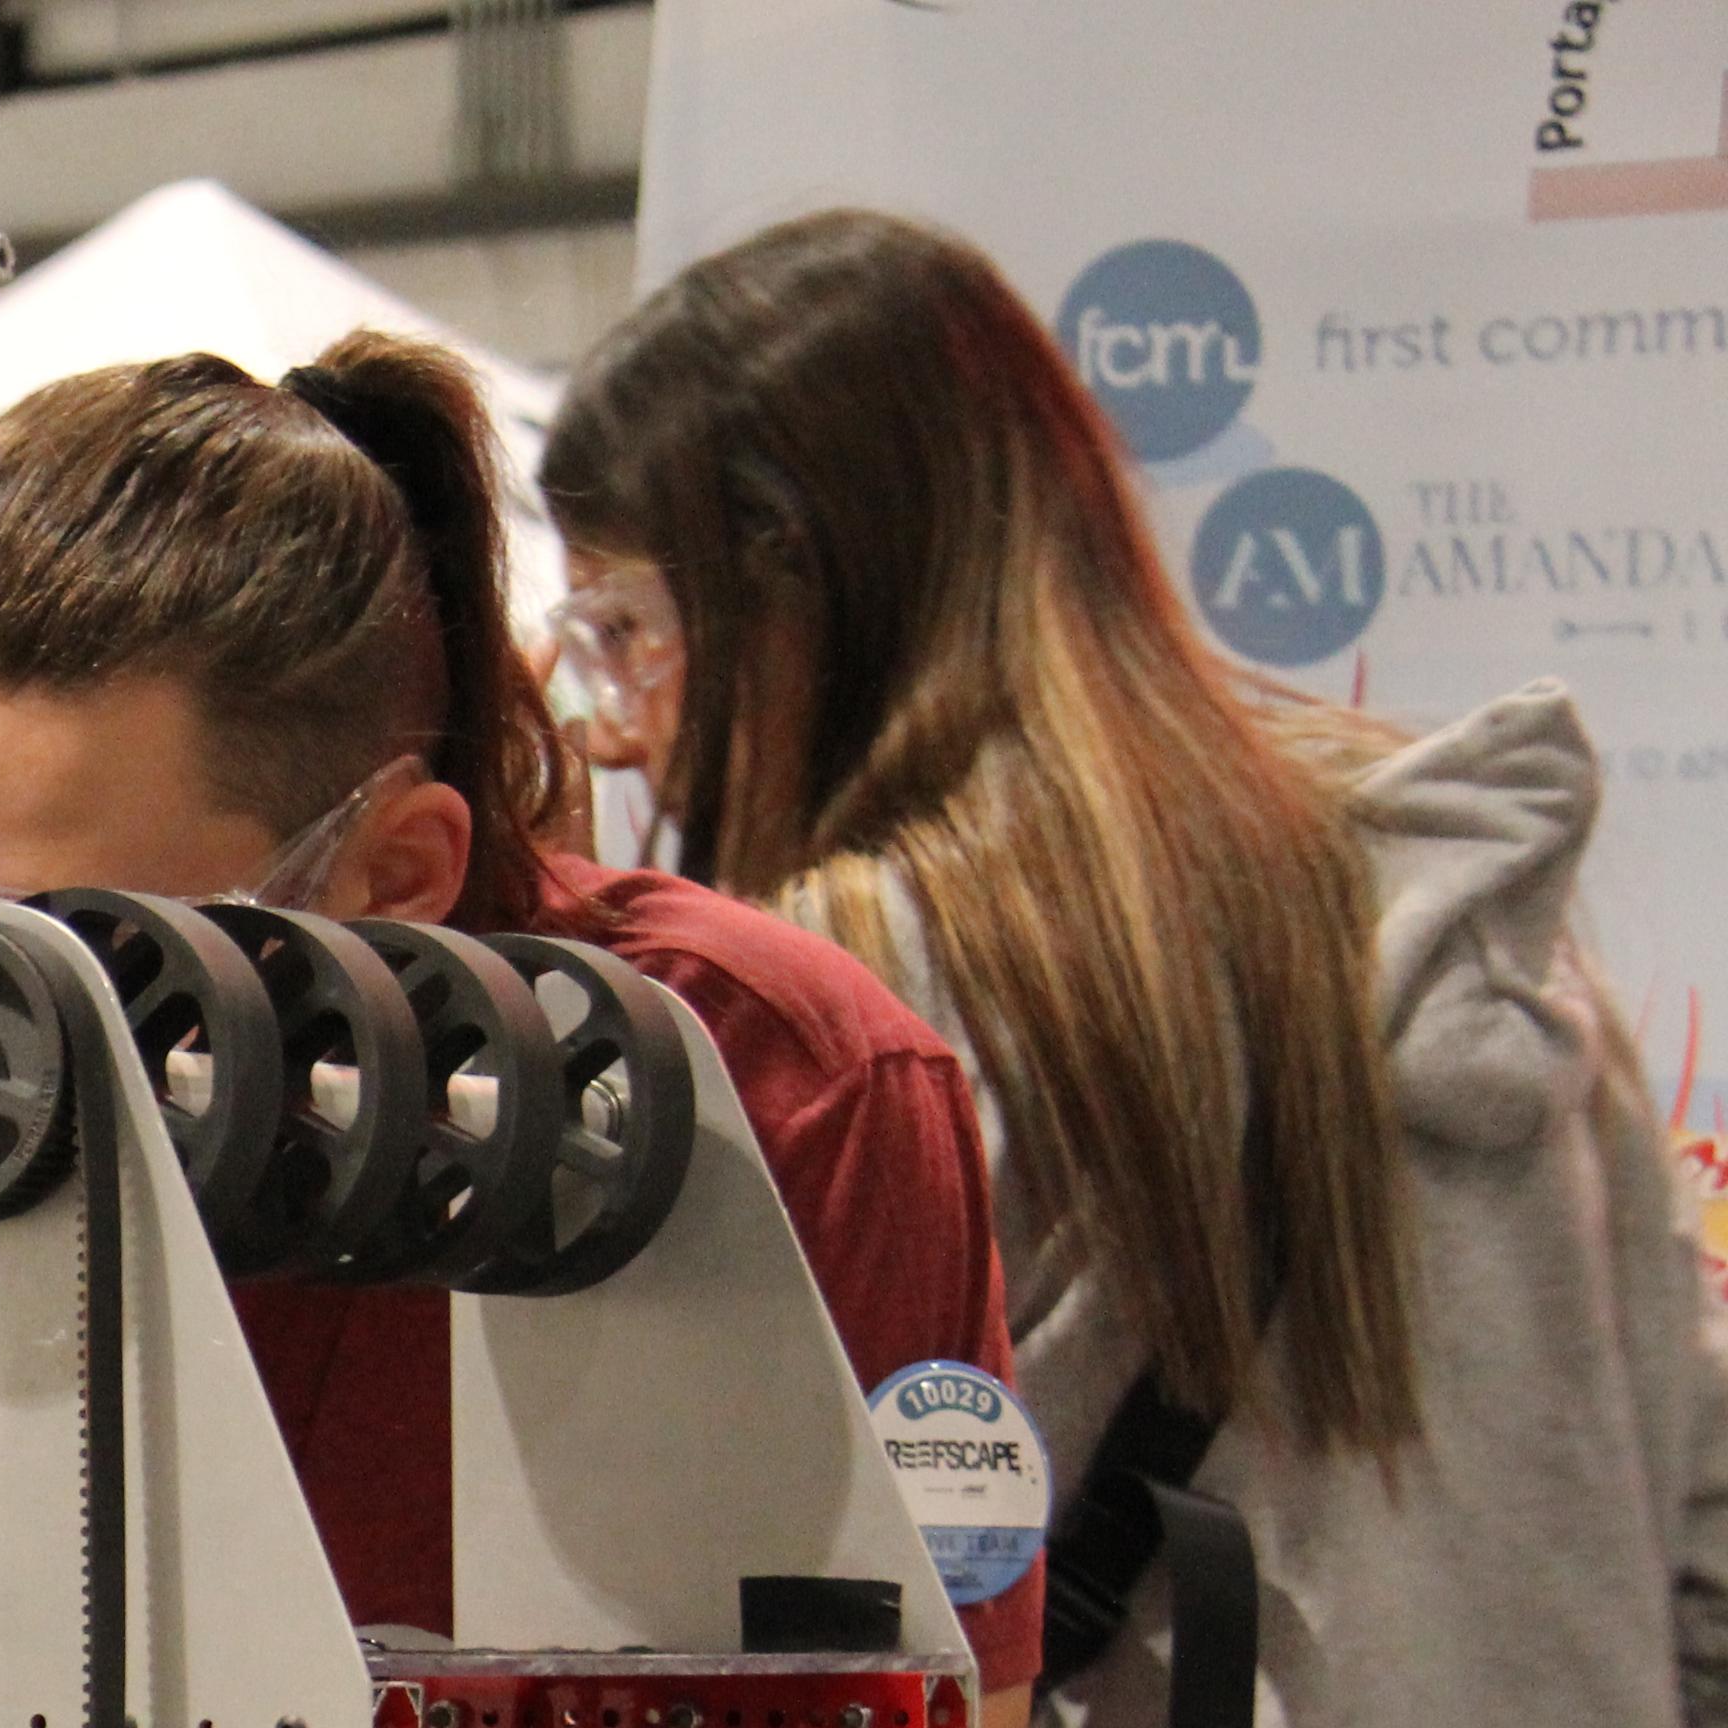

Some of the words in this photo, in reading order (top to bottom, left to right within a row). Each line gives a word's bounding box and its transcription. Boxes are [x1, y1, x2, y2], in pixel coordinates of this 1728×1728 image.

[1535, 0, 1606, 152] Porta
[1317, 312, 1453, 373] first
[1412, 480, 1516, 524] THE
[906, 1383, 993, 1413] 10029
[885, 1439, 1020, 1472] REEFSCAPE
